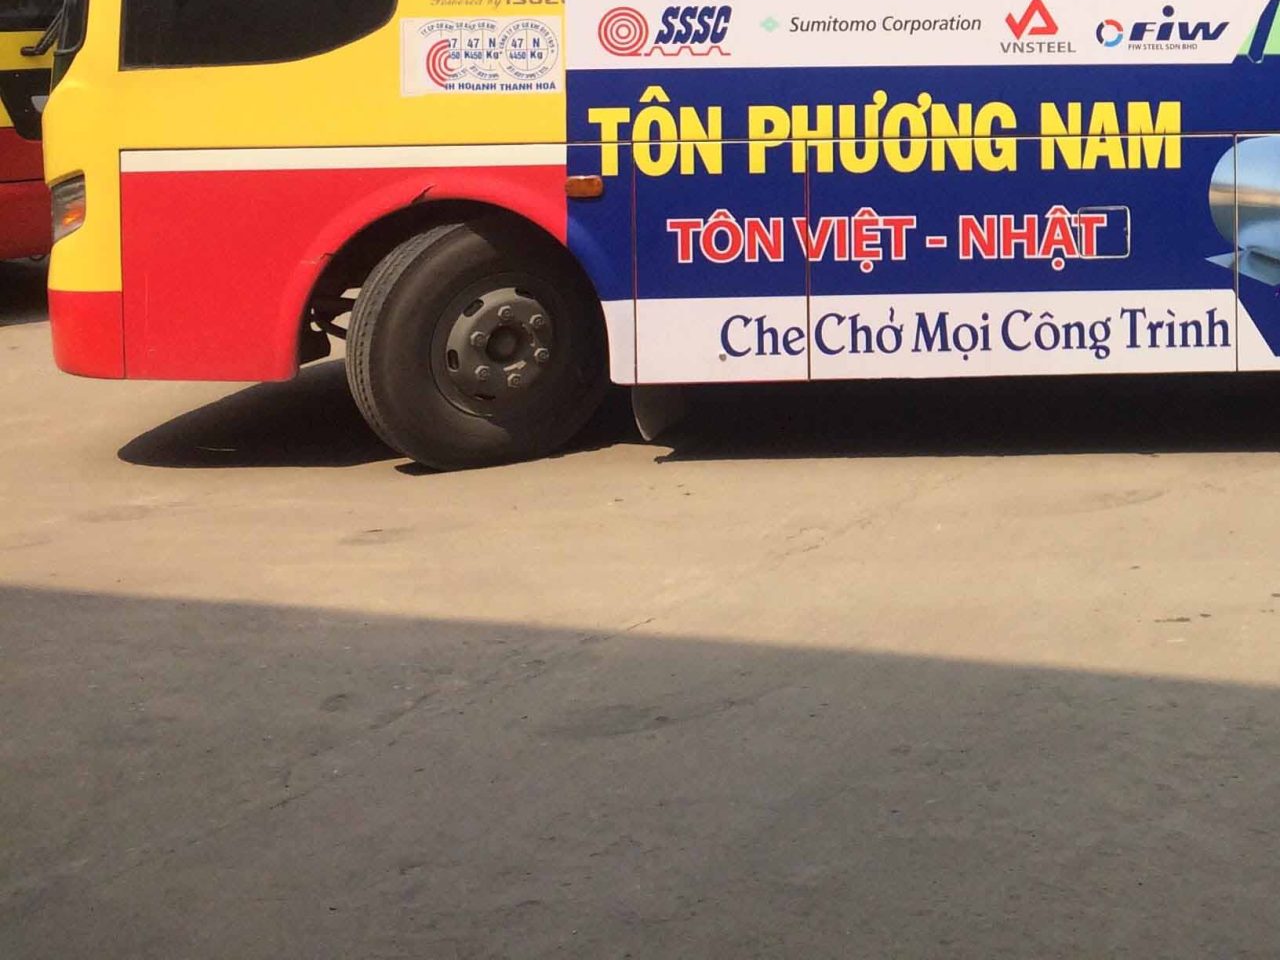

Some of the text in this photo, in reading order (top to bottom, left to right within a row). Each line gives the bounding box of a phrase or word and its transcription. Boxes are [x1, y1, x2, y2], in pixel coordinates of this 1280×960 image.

[653, 5, 732, 45] SSSC
[789, 13, 982, 36] Sumitomo Corporation
[511, 38, 524, 48] 47
[533, 37, 540, 48] N
[1000, 41, 1077, 54] VNSTEEL
[500, 82, 533, 91] THANH
[588, 85, 1182, 177] TÔN PHƯƠNG NAM
[667, 208, 784, 264] TÔN
[791, 206, 917, 274] VIỆT
[958, 204, 1108, 272] NHẬT
[720, 305, 1232, 361] Che Chở Mọi Công Trình
